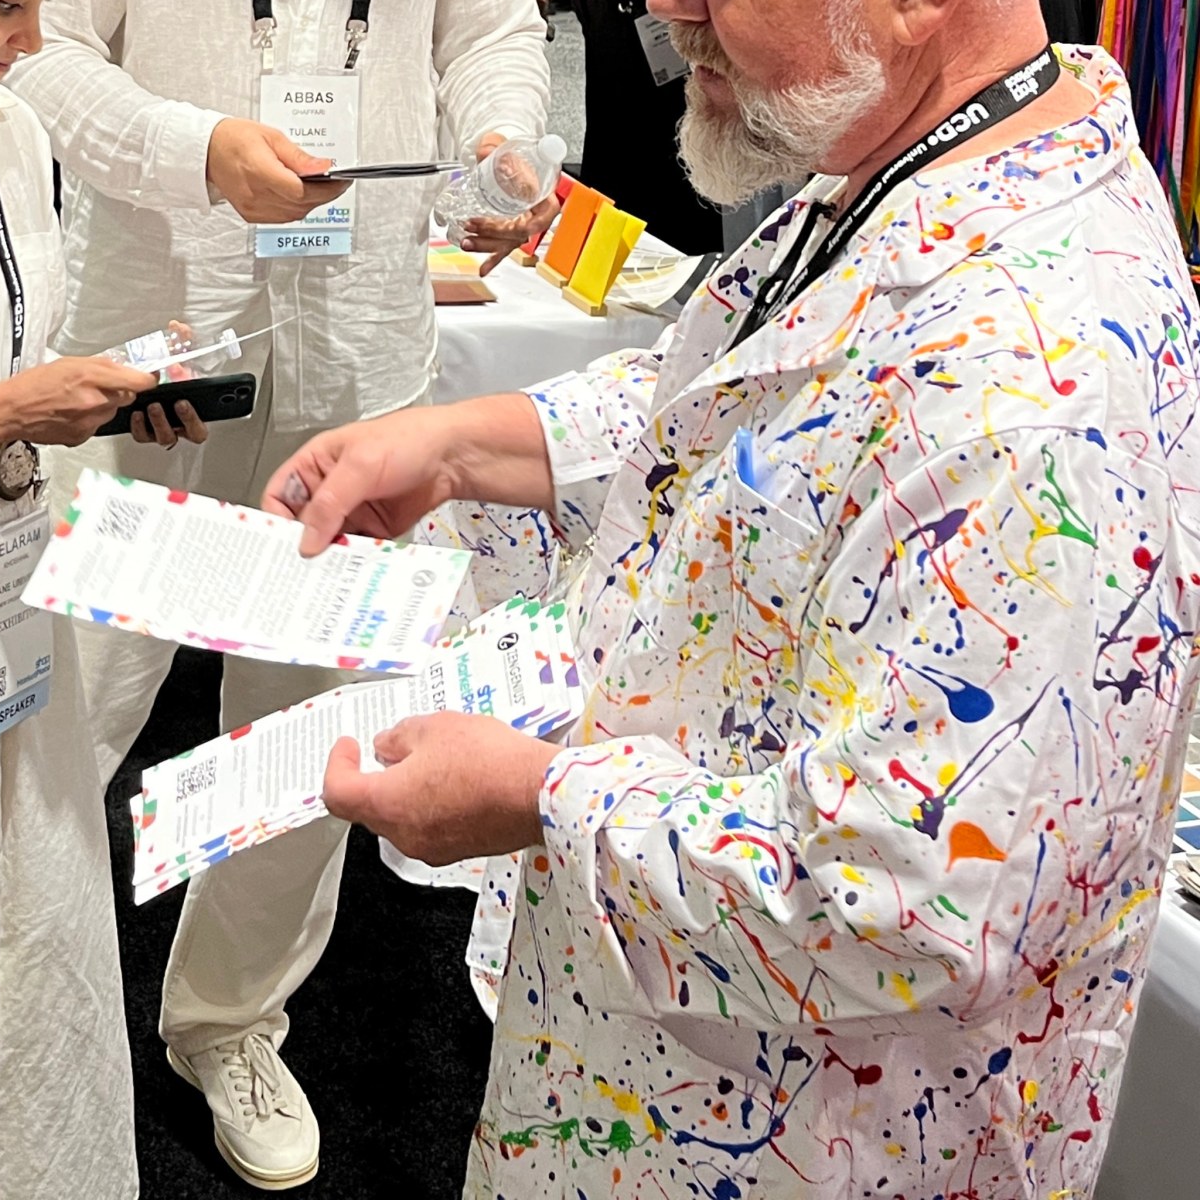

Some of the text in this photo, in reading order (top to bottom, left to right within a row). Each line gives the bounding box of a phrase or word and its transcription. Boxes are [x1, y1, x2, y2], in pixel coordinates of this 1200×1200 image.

[283, 91, 335, 104] ABBAS
[288, 127, 328, 137] TULANE
[934, 102, 990, 142] UCD
[881, 142, 928, 184] Universal
[300, 215, 350, 225] arketPlace
[277, 235, 331, 248] SPEAKER
[456, 652, 476, 715] MarketPla
[0, 693, 36, 723] SPEAKER
